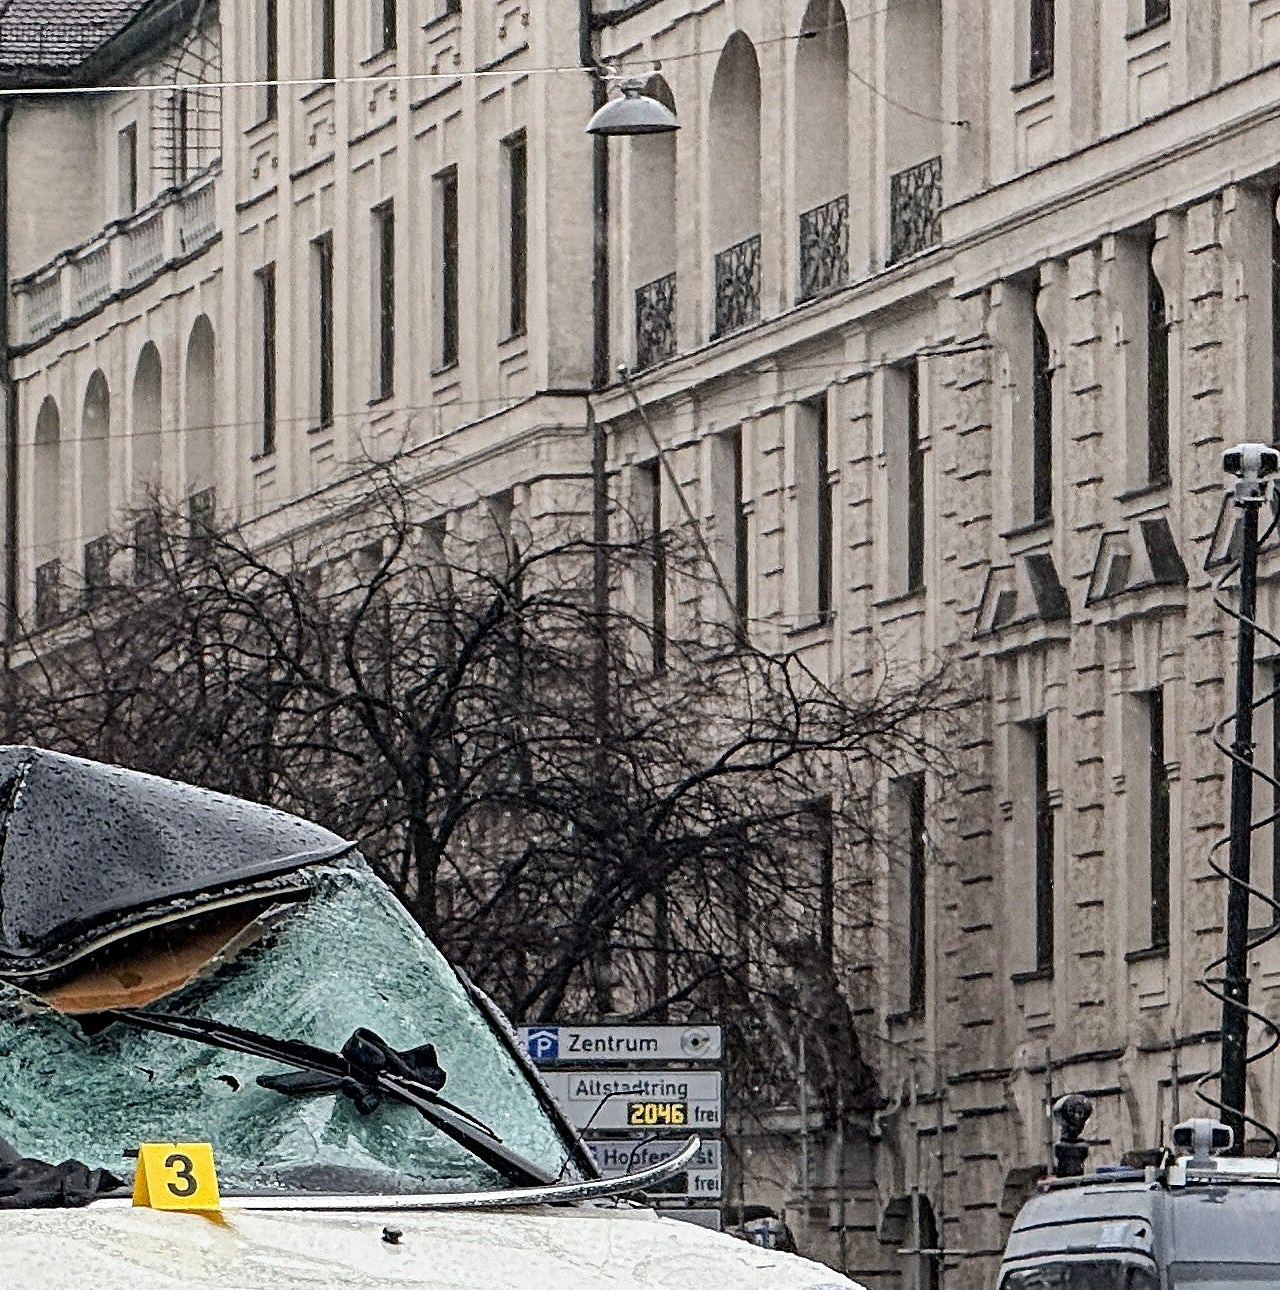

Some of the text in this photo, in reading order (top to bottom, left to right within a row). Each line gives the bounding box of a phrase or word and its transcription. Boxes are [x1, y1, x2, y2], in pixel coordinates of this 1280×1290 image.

[568, 1034, 658, 1052] Zentrum
[575, 1079, 688, 1100] Altstadtring
[630, 1103, 719, 1124] 2046 frei
[164, 1153, 198, 1198] 3
[694, 1174, 719, 1191] frei
